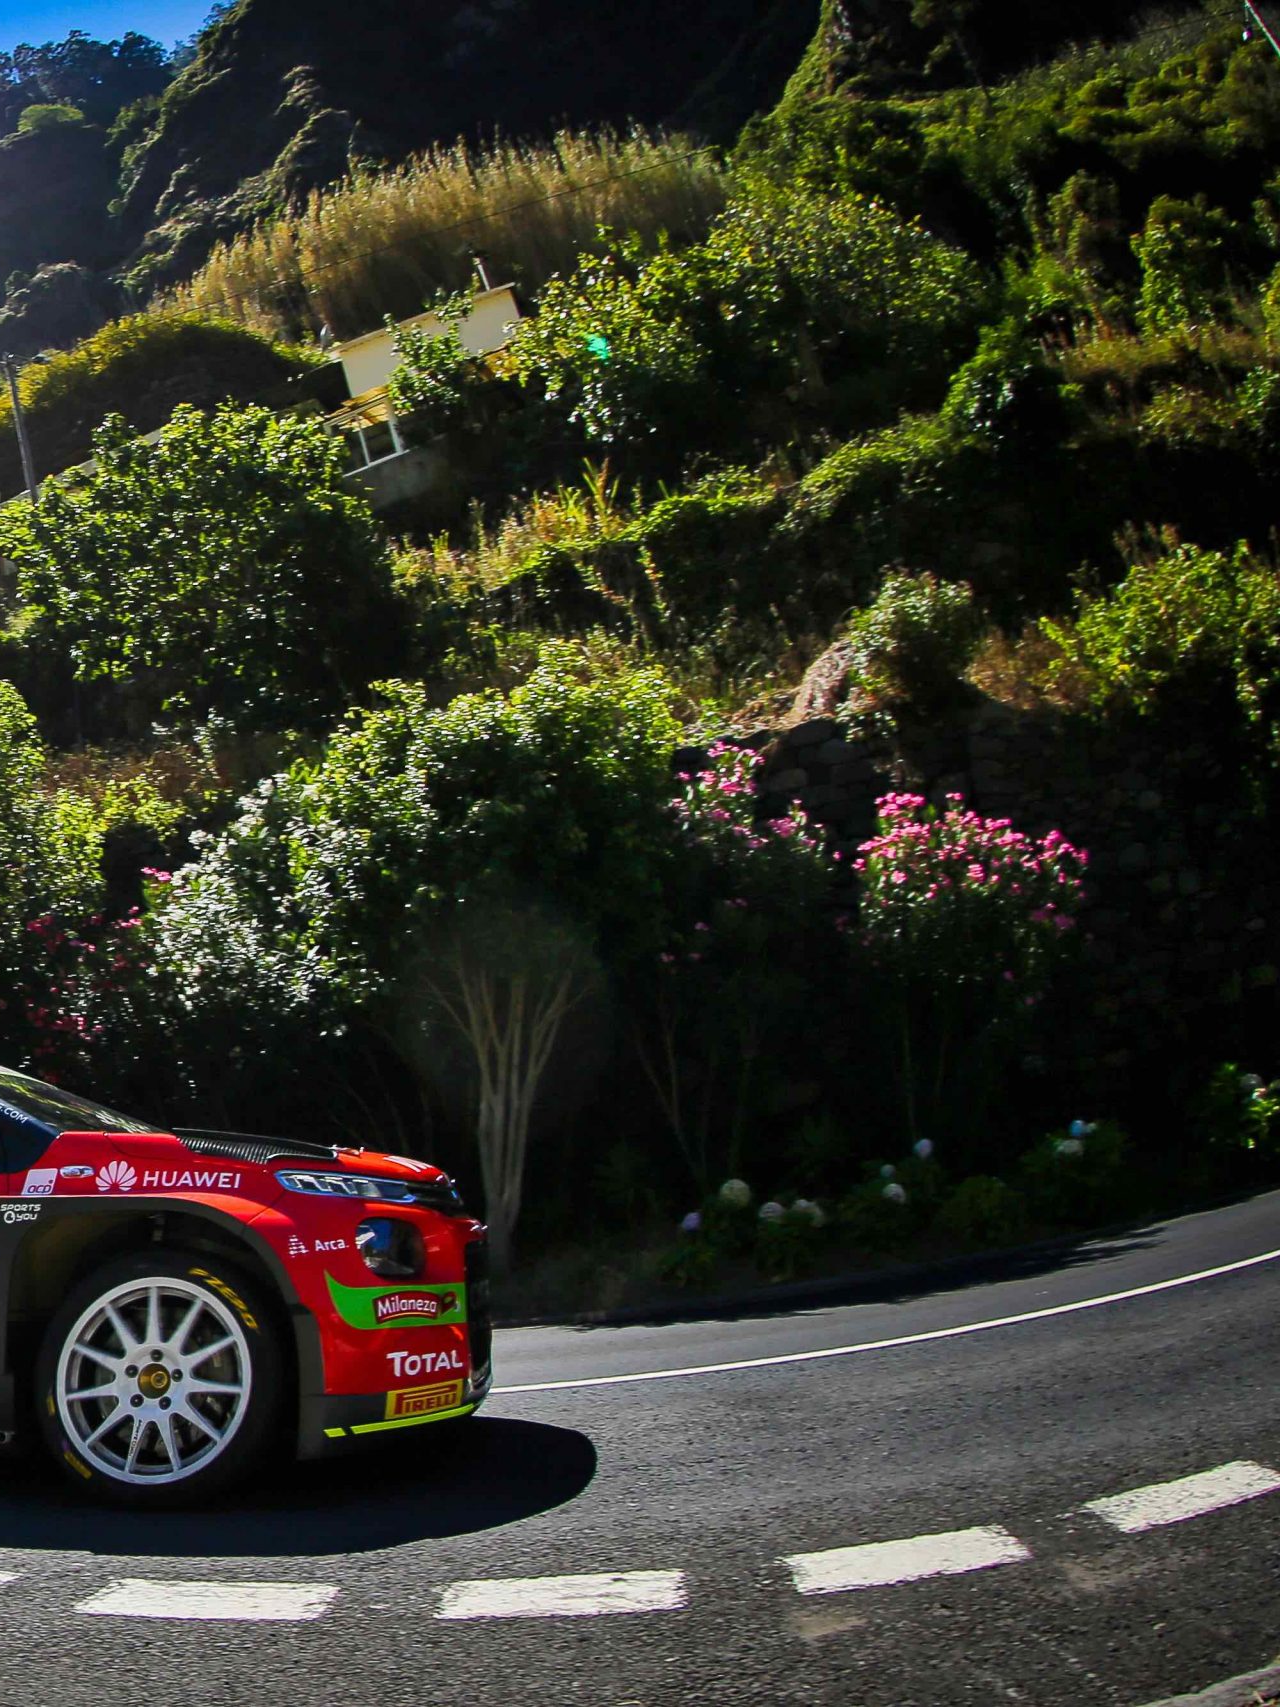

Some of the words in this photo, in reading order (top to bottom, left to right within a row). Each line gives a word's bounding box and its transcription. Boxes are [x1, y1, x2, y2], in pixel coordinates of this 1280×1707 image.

[142, 1170, 241, 1189] HUAWEI
[0, 1204, 41, 1212] SPORTS
[377, 1295, 438, 1317] Milaneza
[386, 1349, 463, 1377] TOTAL
[393, 1384, 458, 1415] PIRELLI
